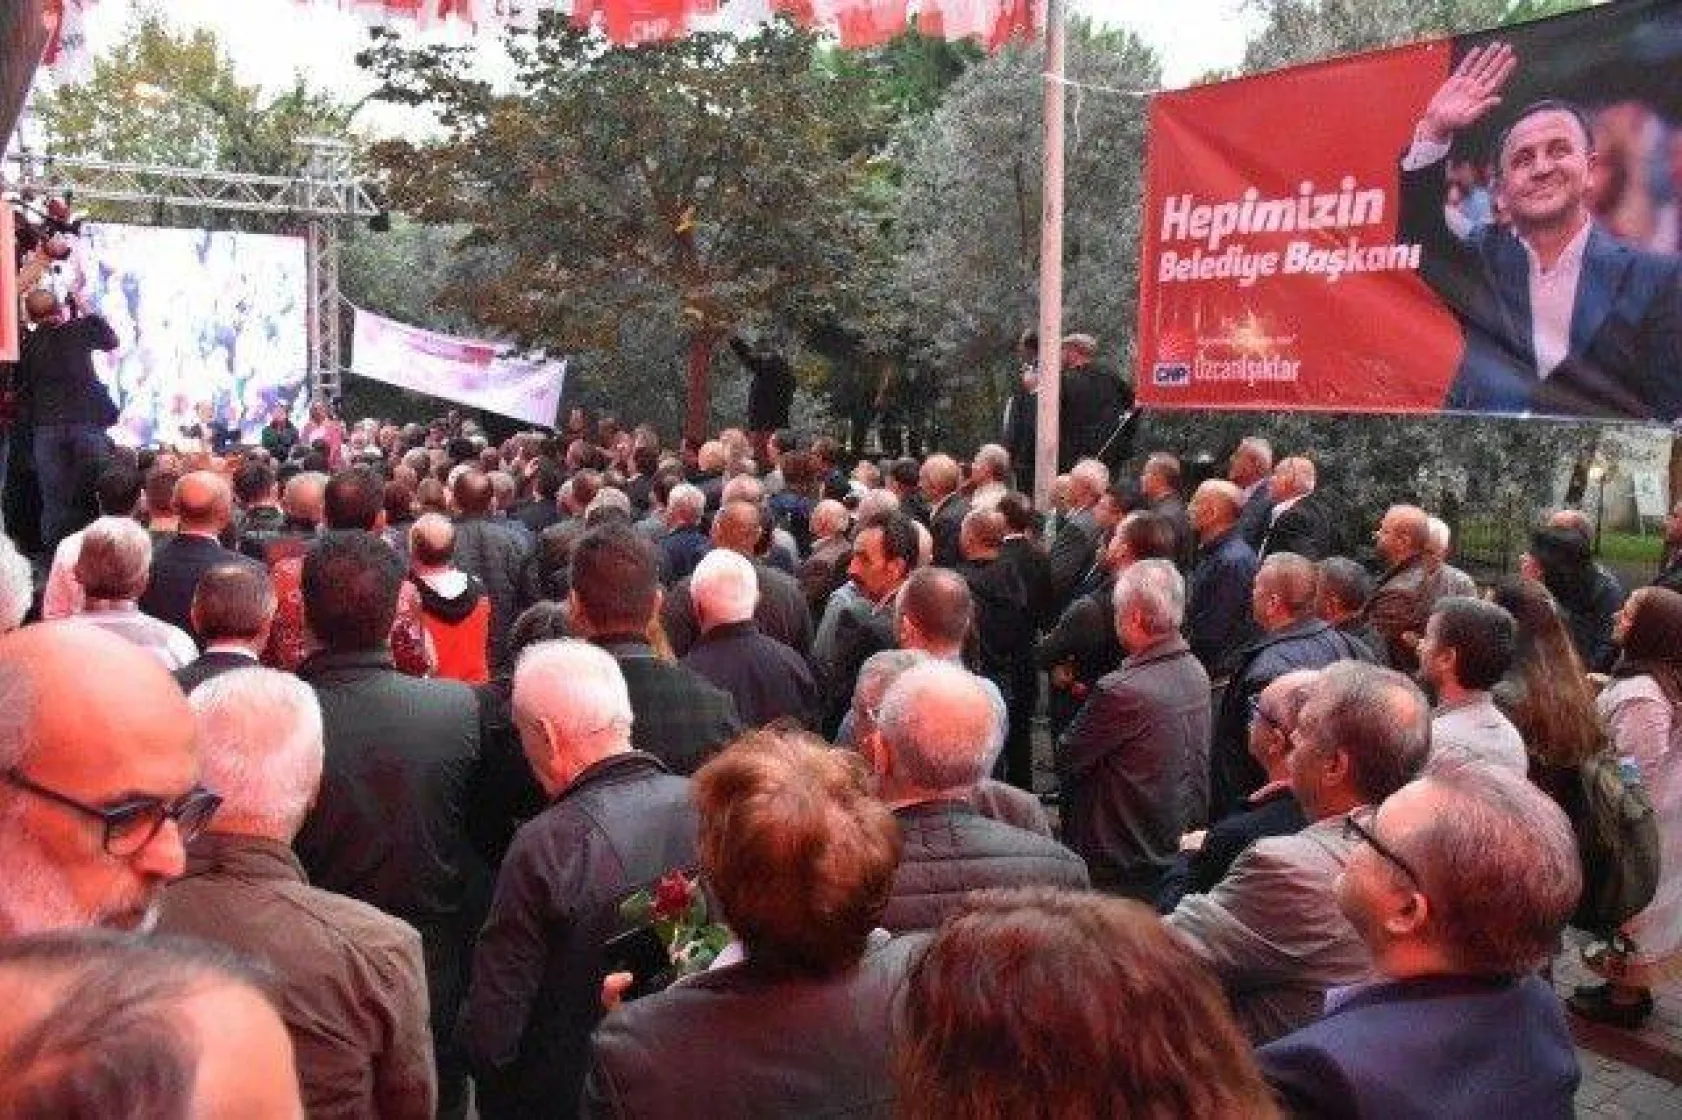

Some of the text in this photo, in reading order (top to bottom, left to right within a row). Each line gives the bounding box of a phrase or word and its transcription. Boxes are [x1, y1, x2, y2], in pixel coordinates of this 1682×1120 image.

[1161, 176, 1385, 250] Hepimizin
[1158, 237, 1421, 287] Belediye Başkanı
